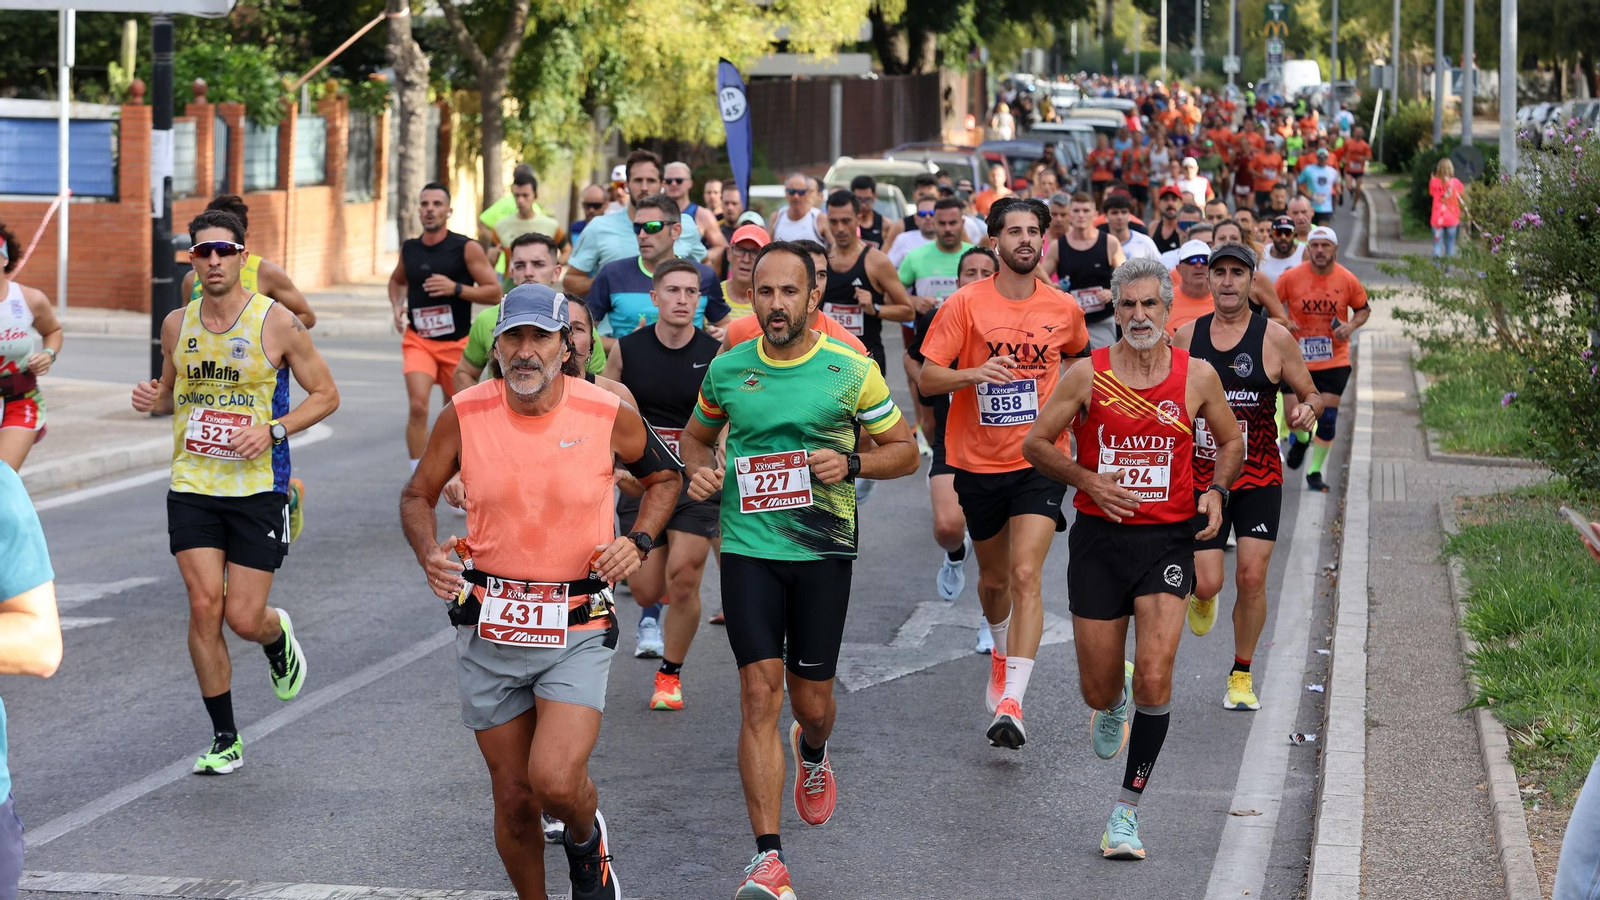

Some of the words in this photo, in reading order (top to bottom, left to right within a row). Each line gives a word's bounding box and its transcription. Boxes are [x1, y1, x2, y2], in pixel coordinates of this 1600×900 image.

[1302, 299, 1337, 312] XXIX
[423, 317, 443, 327] 514
[986, 341, 1049, 363] XXIX
[1304, 345, 1327, 353] 1050
[219, 391, 255, 407] CÁDIZ
[990, 395, 1022, 411] 858
[1224, 389, 1259, 401] NIÓN
[201, 425, 233, 443] 521
[754, 472, 790, 493] 227
[500, 602, 543, 626] 431
